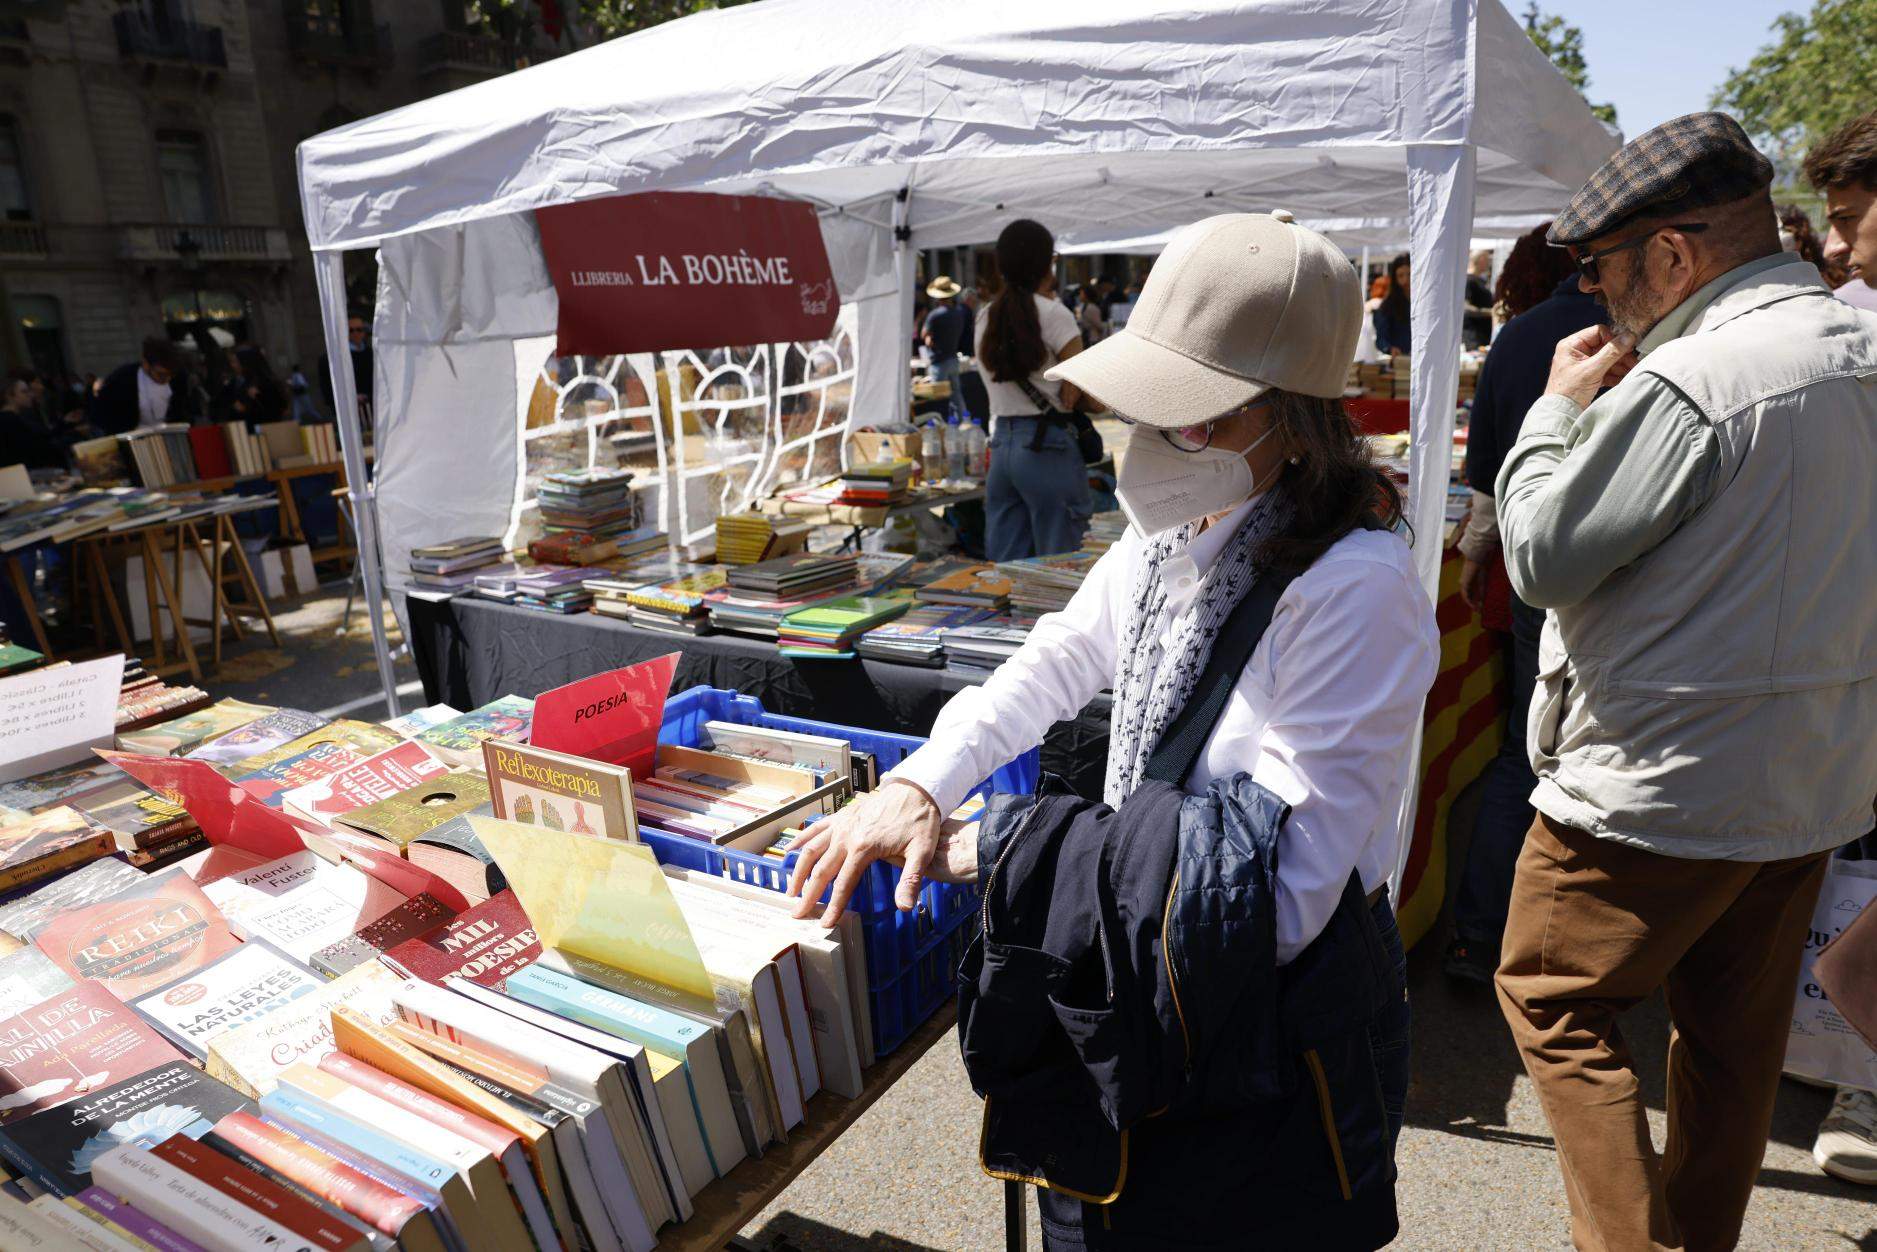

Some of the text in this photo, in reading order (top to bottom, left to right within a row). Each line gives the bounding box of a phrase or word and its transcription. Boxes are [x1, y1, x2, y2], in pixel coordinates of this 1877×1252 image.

[571, 248, 793, 287] LLIBRERIA LA BOHÈME
[574, 692, 628, 724] POESIA
[496, 750, 601, 797] Reflexoterapia
[177, 839, 189, 848] AND
[268, 865, 317, 888] Fuster
[78, 906, 189, 964] REIKI
[440, 919, 499, 955] MIL
[443, 920, 465, 932] les
[92, 926, 201, 973] TRADICIONAL
[438, 929, 537, 985] POESIE
[462, 933, 504, 958] millors
[500, 957, 529, 975] de la
[38, 997, 87, 1027] DE
[177, 1006, 223, 1030] LAS
[227, 969, 292, 1006] LEYES
[188, 976, 302, 1037] NATURALES
[581, 991, 658, 1024] GERMANS
[271, 1018, 334, 1065] Criad
[71, 1072, 192, 1127] DE LA MENTE
[73, 1067, 184, 1117] ALREDEDOR
[169, 1079, 200, 1095] ORTEGA
